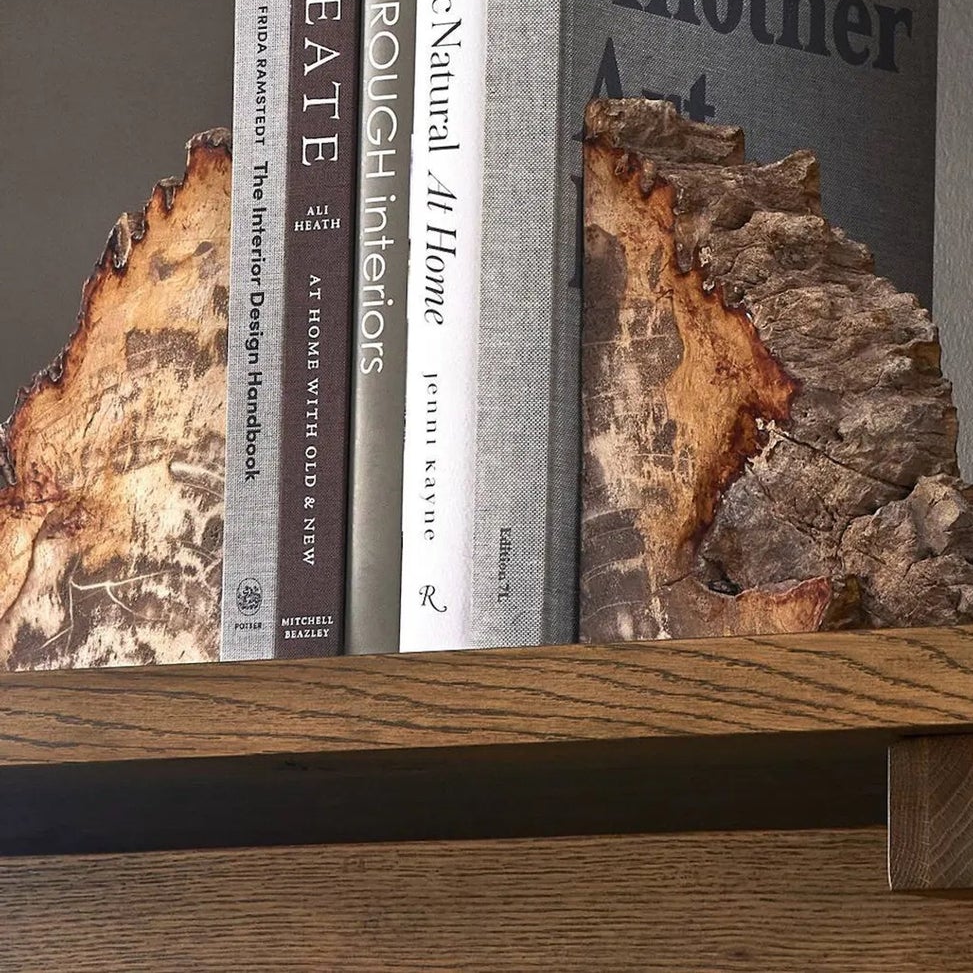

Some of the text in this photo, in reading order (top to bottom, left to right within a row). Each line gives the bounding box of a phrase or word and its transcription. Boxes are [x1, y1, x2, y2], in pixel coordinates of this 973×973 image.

[255, 5, 269, 146] FRIDA RAMSTEDT
[428, 18, 463, 153] Natural
[572, 37, 716, 141] At
[294, 218, 341, 232] HEATH
[307, 205, 329, 216] ALI
[360, 1, 400, 375] ROUGH interiors
[427, 169, 458, 214] At
[245, 161, 269, 483] The Interior Design Handbook
[424, 224, 457, 326] Home
[302, 275, 321, 566] AT HOME WITH OLD & NEW
[281, 615, 334, 627] MITCHELL
[284, 628, 330, 639] BEAZLEY
[418, 585, 448, 613] R
